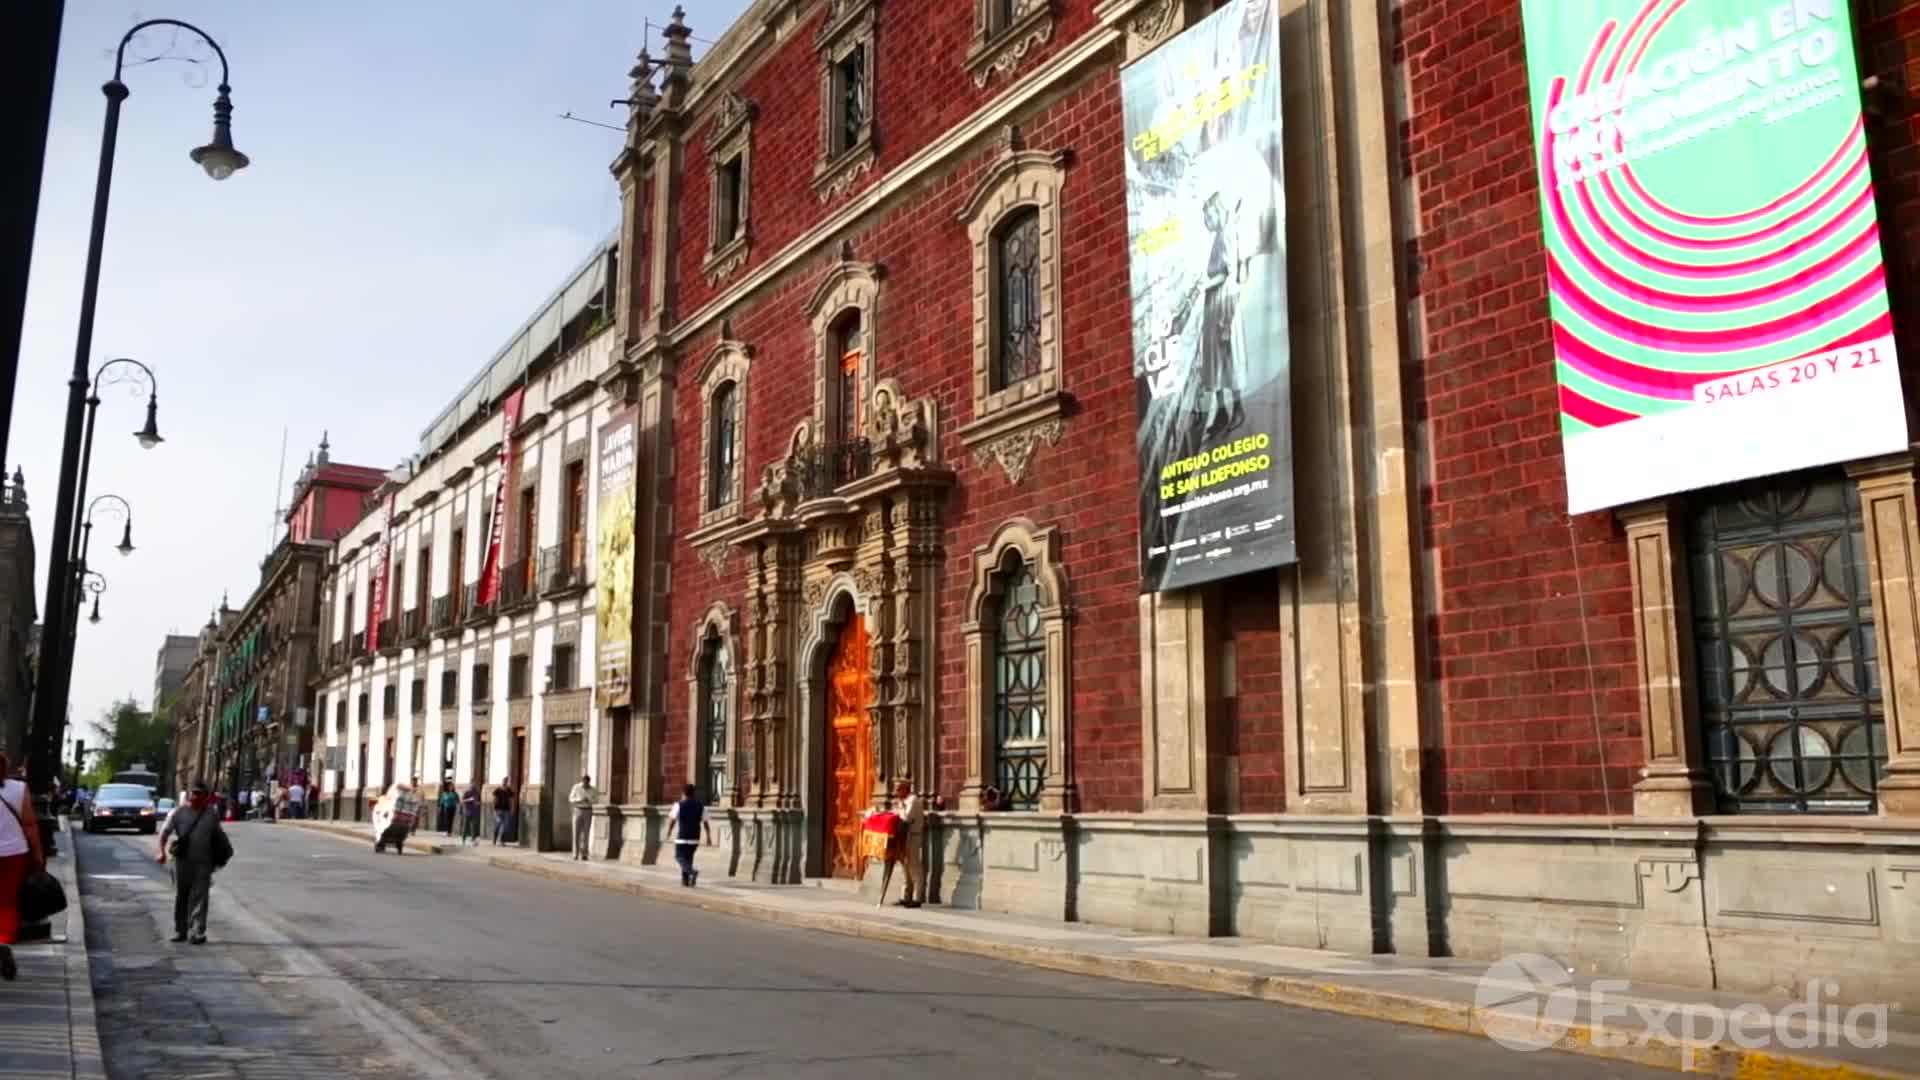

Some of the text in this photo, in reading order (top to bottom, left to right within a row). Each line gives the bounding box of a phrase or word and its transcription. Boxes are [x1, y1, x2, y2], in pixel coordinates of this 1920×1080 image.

[1703, 346, 1882, 404] SALAS 20 Y 21
[1160, 454, 1271, 500] DE SAN ILDEFONSO
[1161, 433, 1269, 480] ANTIGUO COLEGIO
